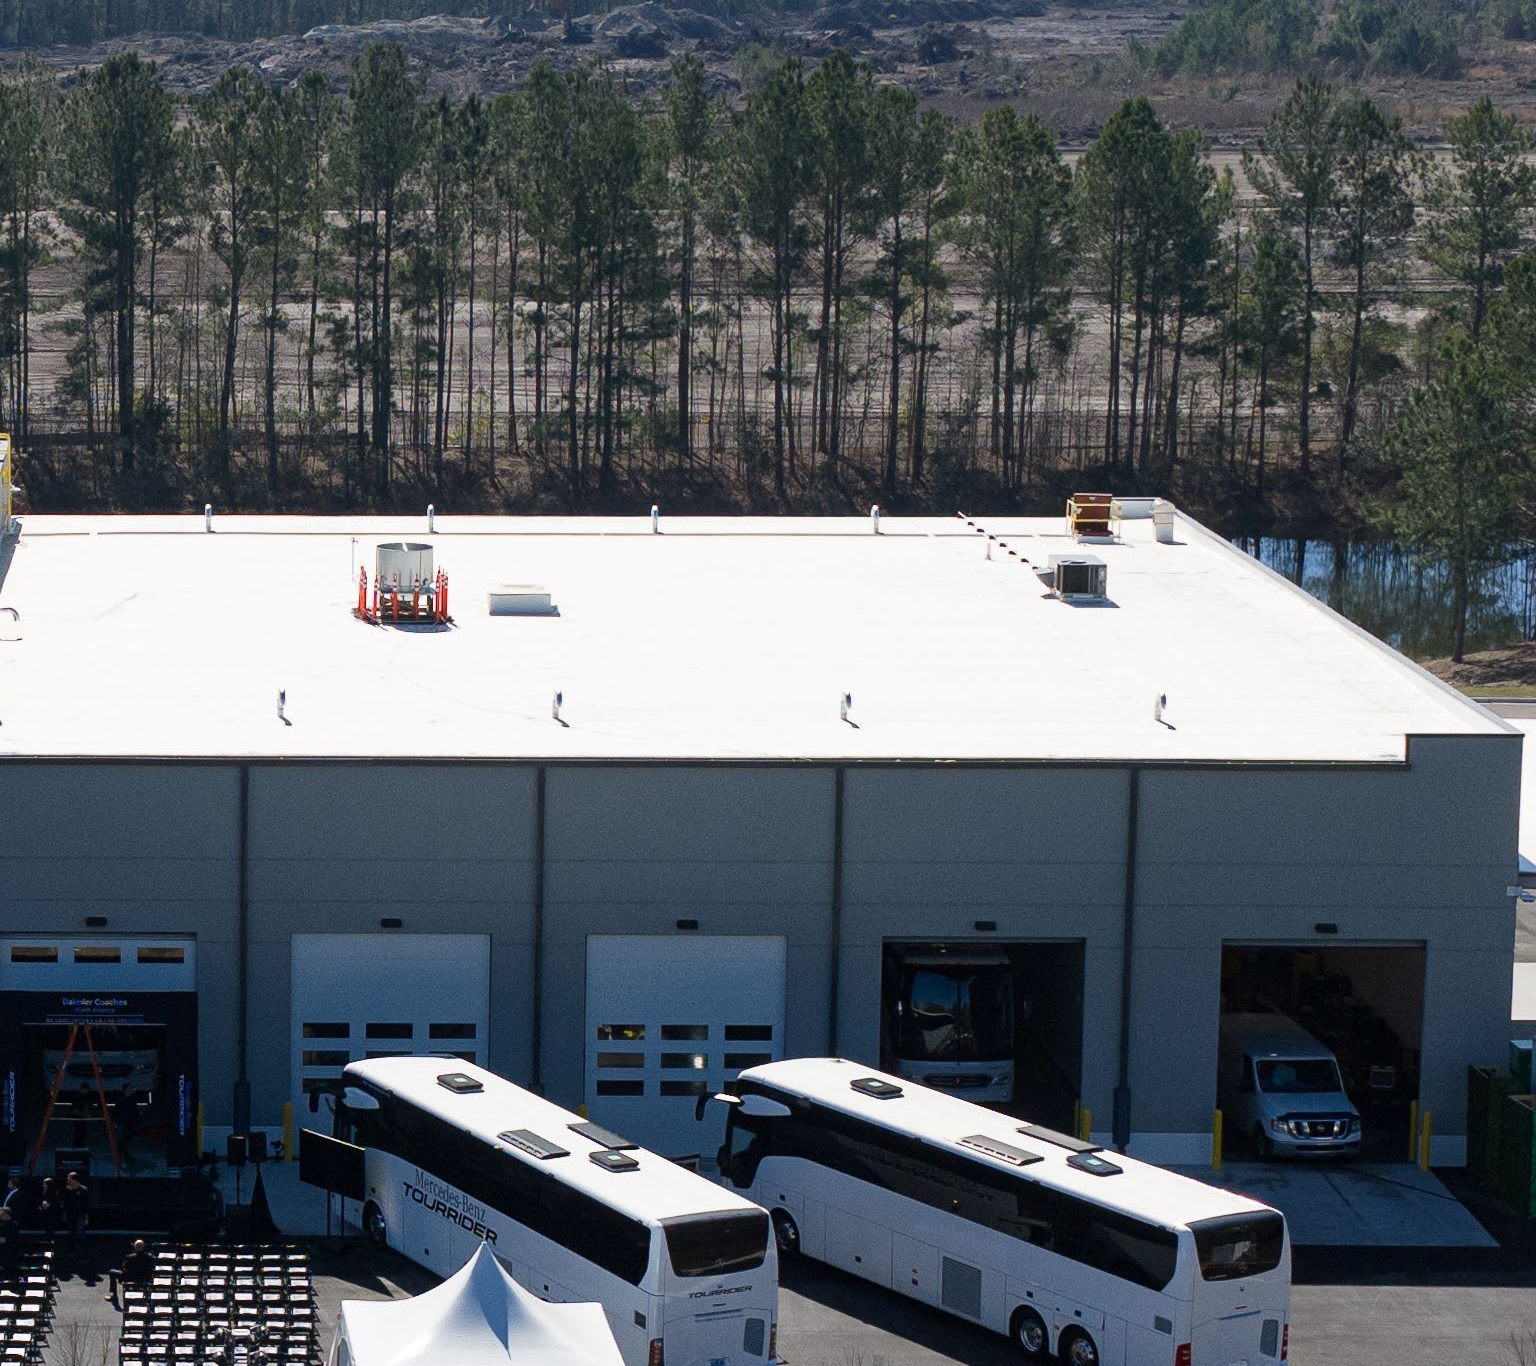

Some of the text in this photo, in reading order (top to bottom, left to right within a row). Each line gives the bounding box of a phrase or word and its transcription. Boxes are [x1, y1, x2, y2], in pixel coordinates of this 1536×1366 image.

[402, 1181, 498, 1246] TOURRIDER
[415, 1168, 487, 1223] Mercedes-Benz
[688, 1285, 753, 1299] TOURRIDER
